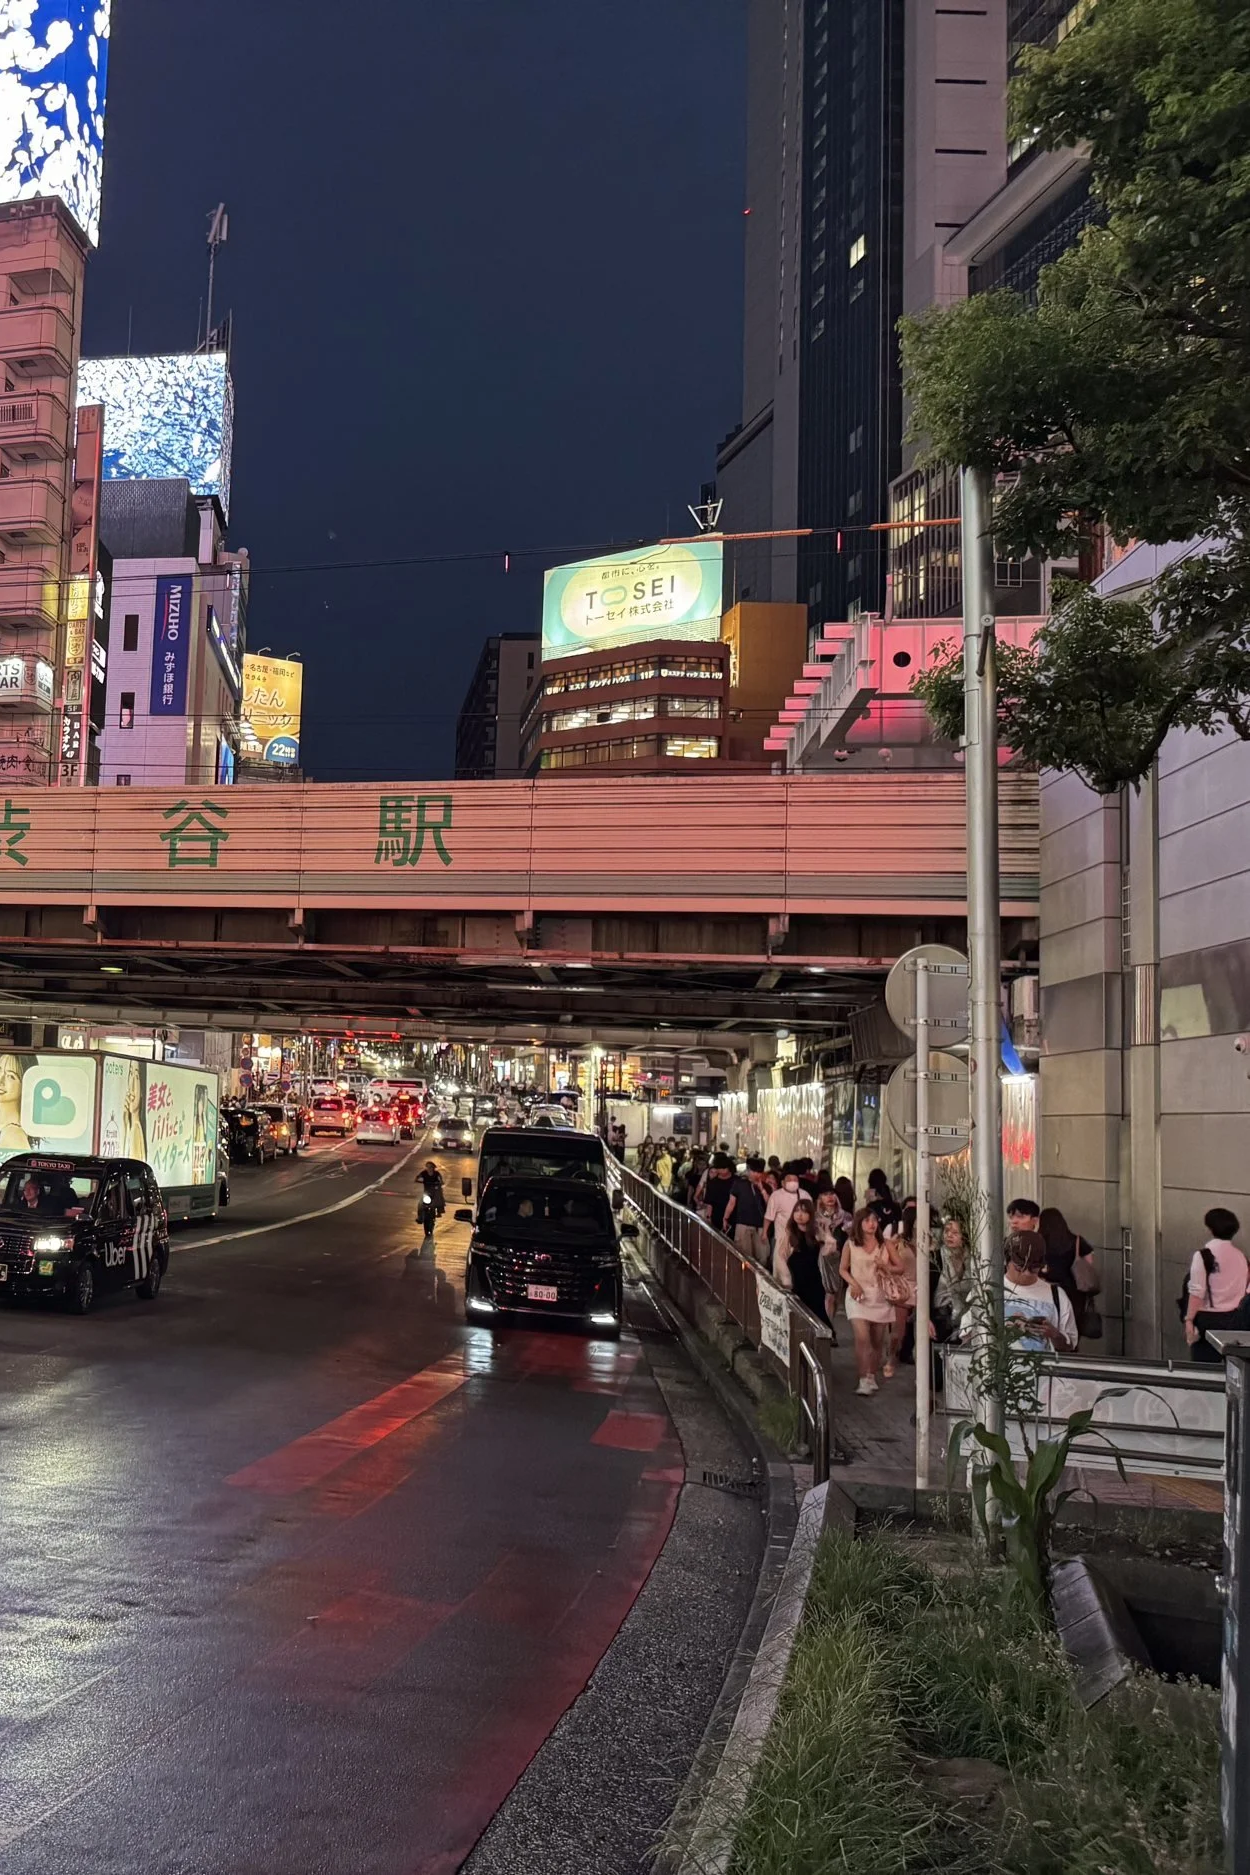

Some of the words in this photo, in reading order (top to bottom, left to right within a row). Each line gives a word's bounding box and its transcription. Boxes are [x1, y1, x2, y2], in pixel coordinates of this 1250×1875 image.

[585, 575, 675, 610] TOSEI
[168, 585, 182, 641] MIZUHO
[586, 598, 675, 626] トーセイ株式会社
[162, 652, 176, 705] みずほ銀行
[640, 670, 655, 680] 11F
[62, 716, 71, 752] カラオケ
[62, 764, 78, 777] 3F
[104, 1241, 127, 1267] Uber
